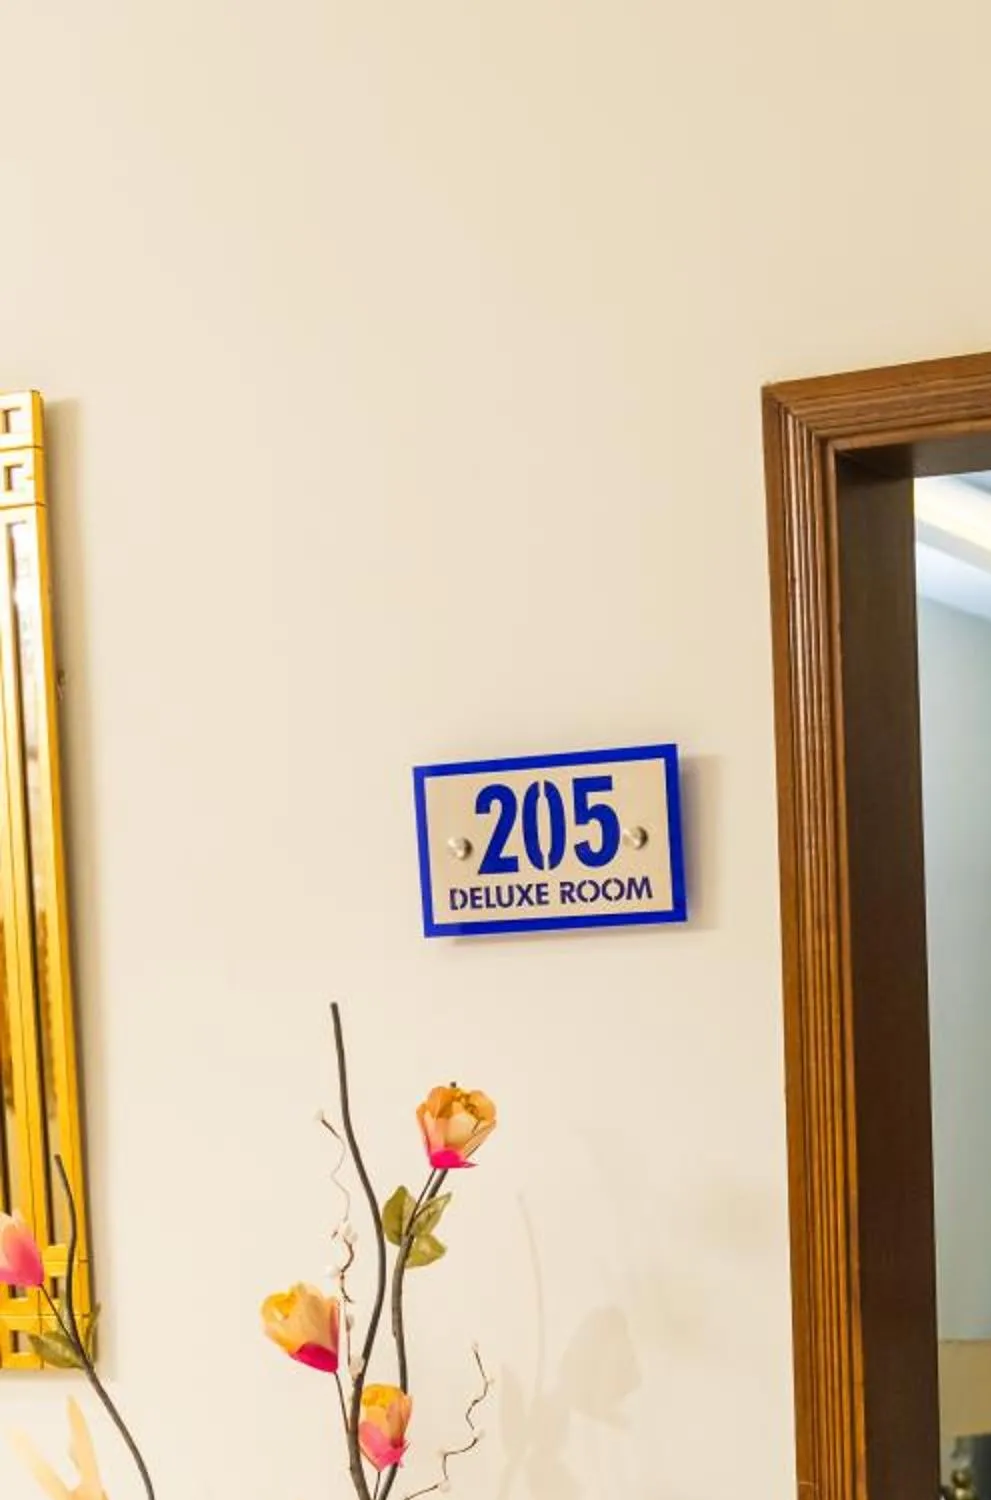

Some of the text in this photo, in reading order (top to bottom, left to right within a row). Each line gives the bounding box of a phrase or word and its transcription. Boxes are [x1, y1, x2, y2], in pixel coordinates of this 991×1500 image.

[475, 775, 621, 875] 205
[449, 876, 653, 911] DELUXE ROOM
